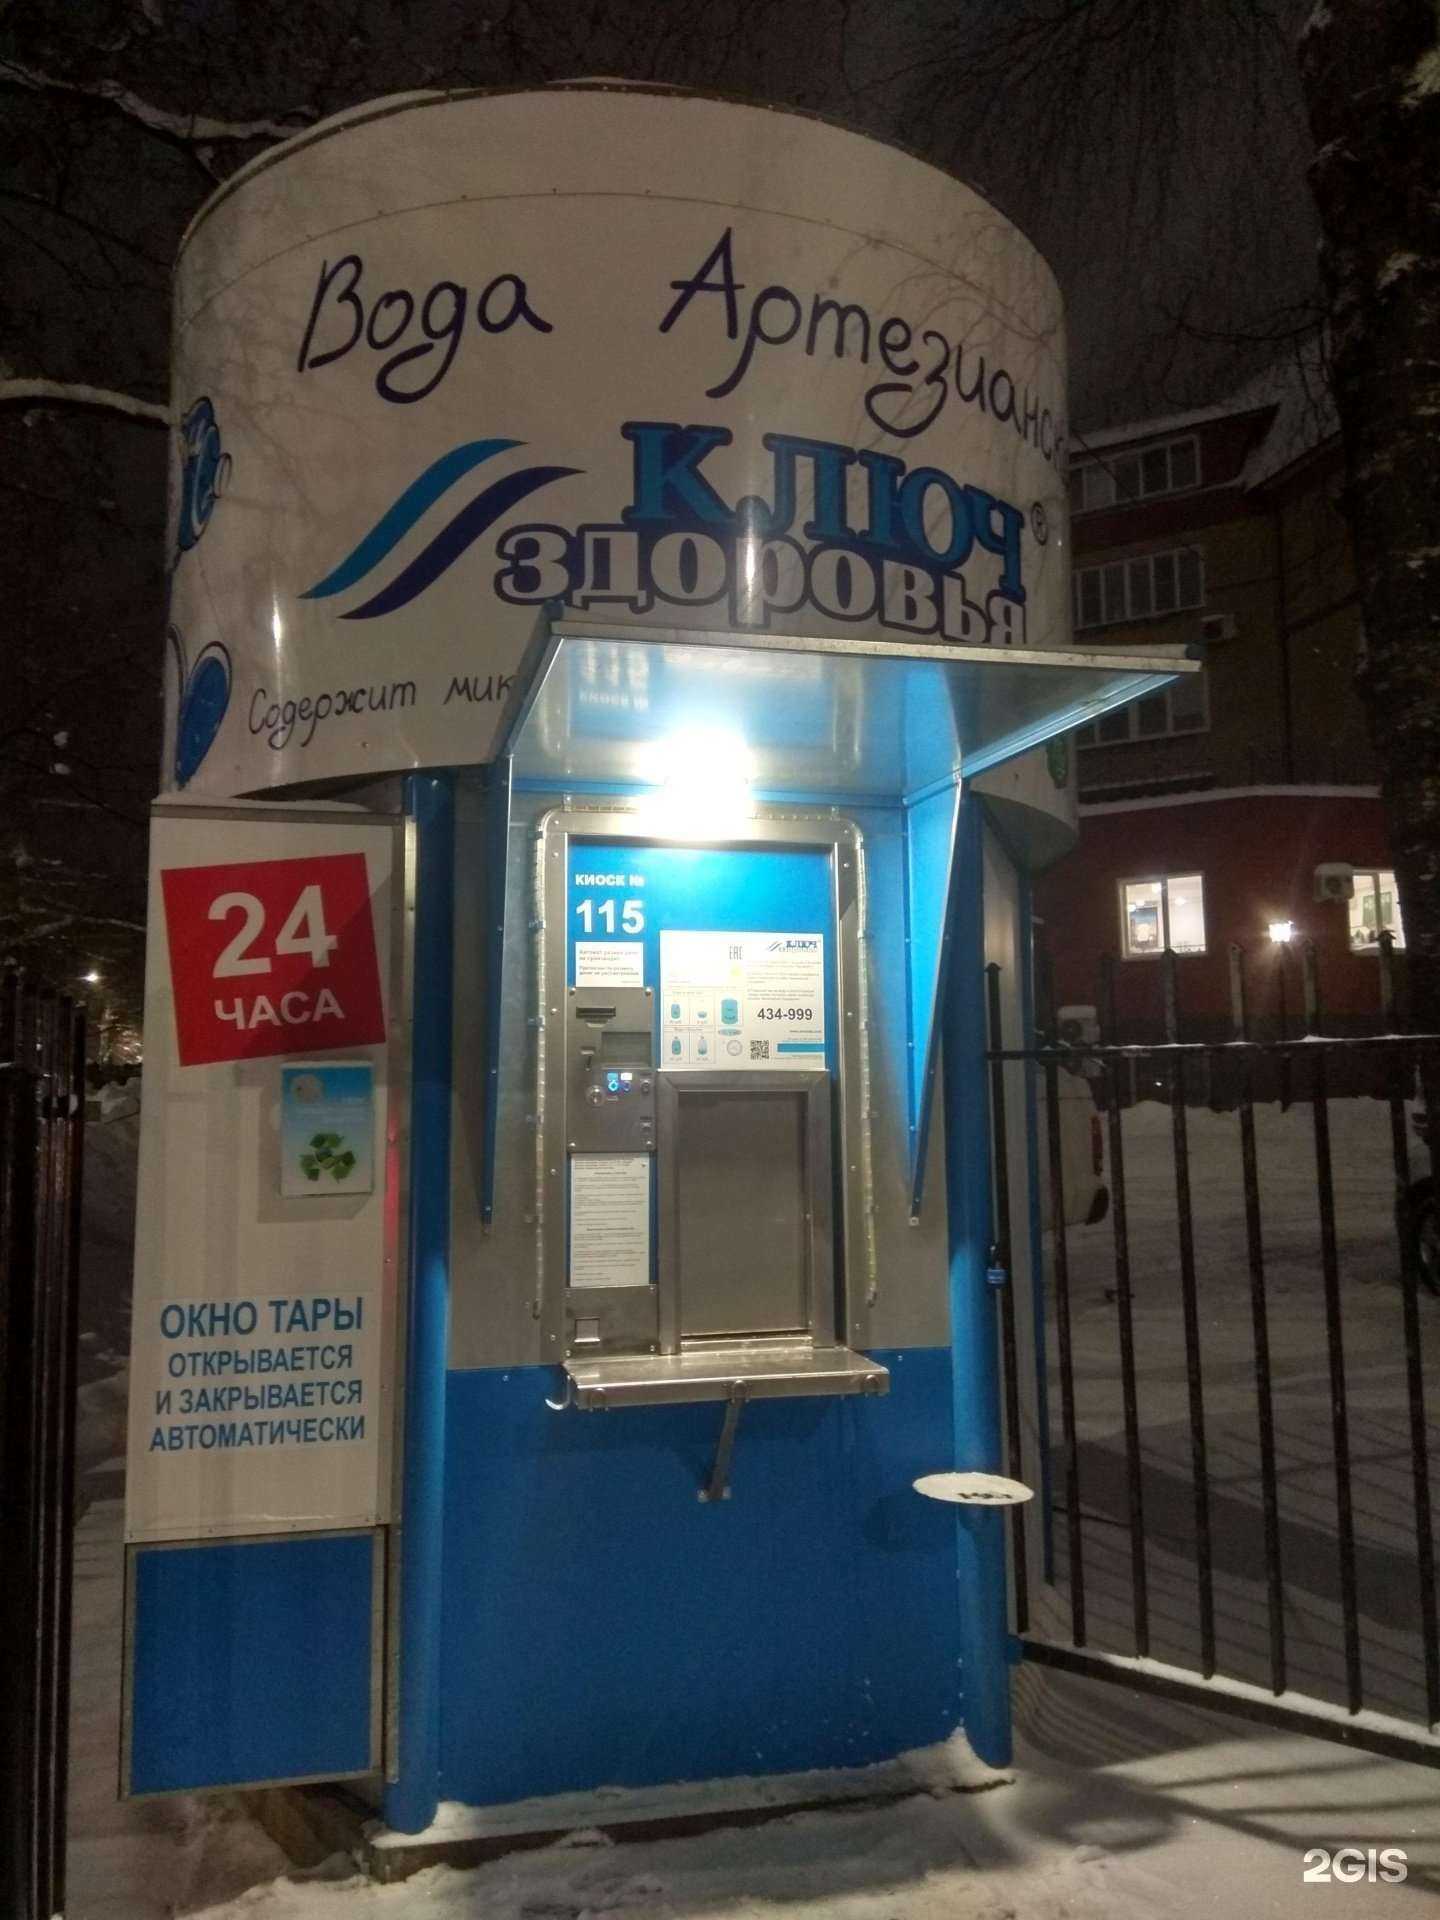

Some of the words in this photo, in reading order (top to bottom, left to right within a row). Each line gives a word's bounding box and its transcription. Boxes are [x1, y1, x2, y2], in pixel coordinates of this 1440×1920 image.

[298, 254, 554, 404] Вода
[620, 420, 1026, 603] КЛЮЧ
[247, 682, 417, 750] Содержит
[575, 873, 625, 887] КИОСК
[207, 884, 339, 979] 24
[576, 899, 645, 934] 115
[213, 988, 345, 1031] ЧАСА
[757, 1007, 813, 1021] 434-999
[160, 1301, 258, 1340] ОКНО
[268, 1296, 364, 1334] ТАРЫ
[168, 1344, 353, 1378] ОТКРЫВАЕТСЯ
[155, 1390, 172, 1415] И
[178, 1379, 363, 1415] ЗАКРЫВАЕТСЯ
[149, 1415, 366, 1452] АВТОМАТИЧЕСКИ
